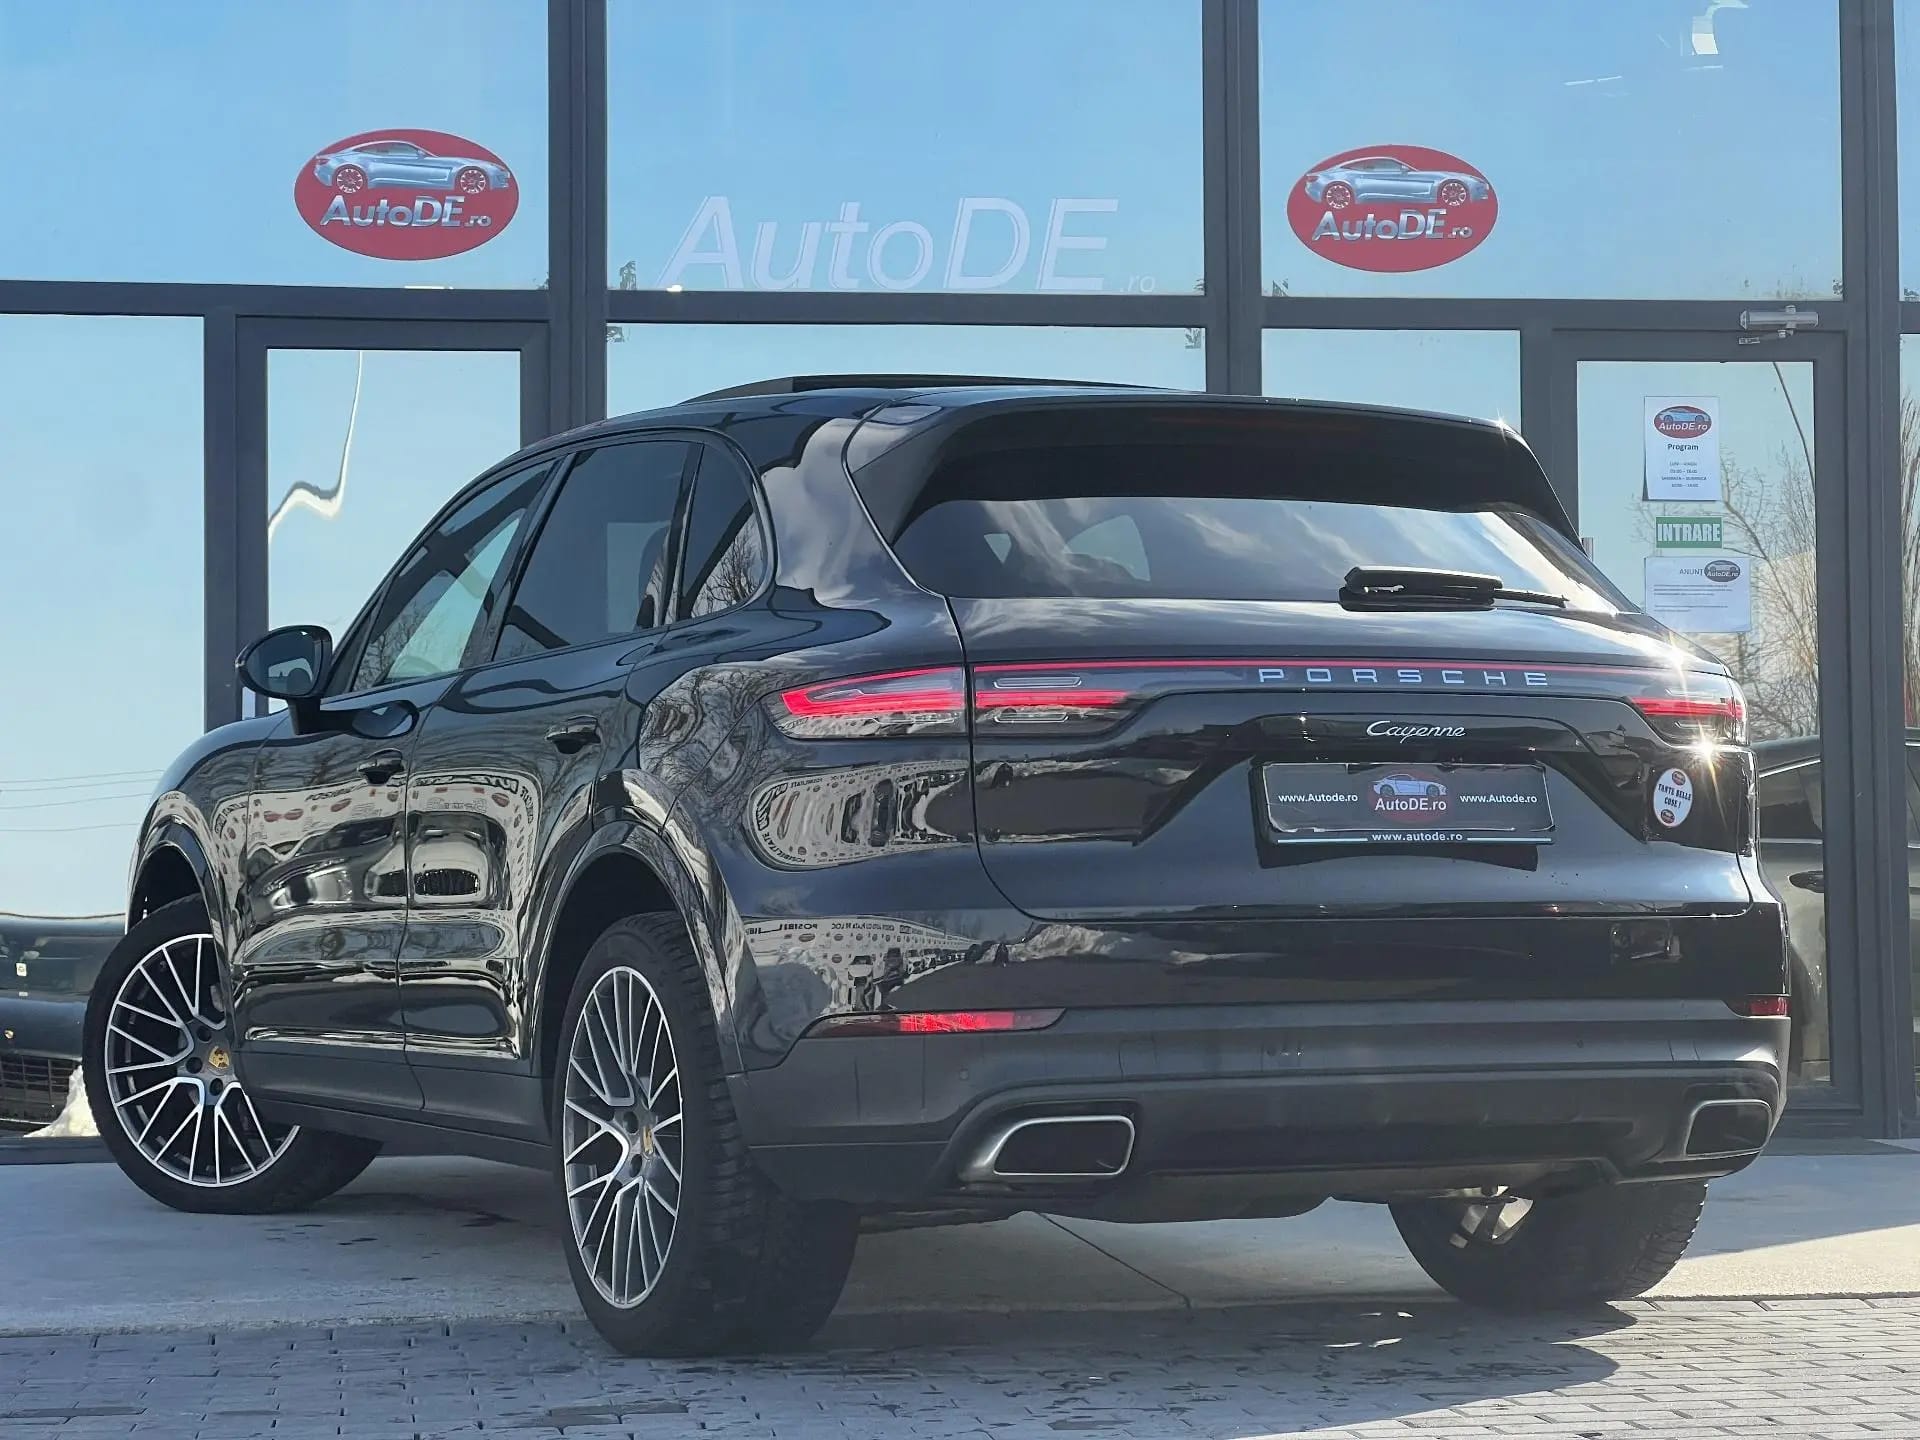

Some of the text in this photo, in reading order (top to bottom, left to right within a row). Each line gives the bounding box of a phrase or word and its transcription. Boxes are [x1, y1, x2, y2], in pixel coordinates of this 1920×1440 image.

[1667, 443, 1699, 452] Program
[1657, 523, 1721, 542] INTRARE
[1258, 668, 1549, 686] PORSCHE
[1366, 720, 1466, 744] Cayenne
[1278, 793, 1359, 803] www.Autode.ro
[1375, 797, 1448, 812] AutoDE.ro
[1459, 793, 1538, 804] www.Autode.ro
[1371, 831, 1464, 843] www.autode.ro
